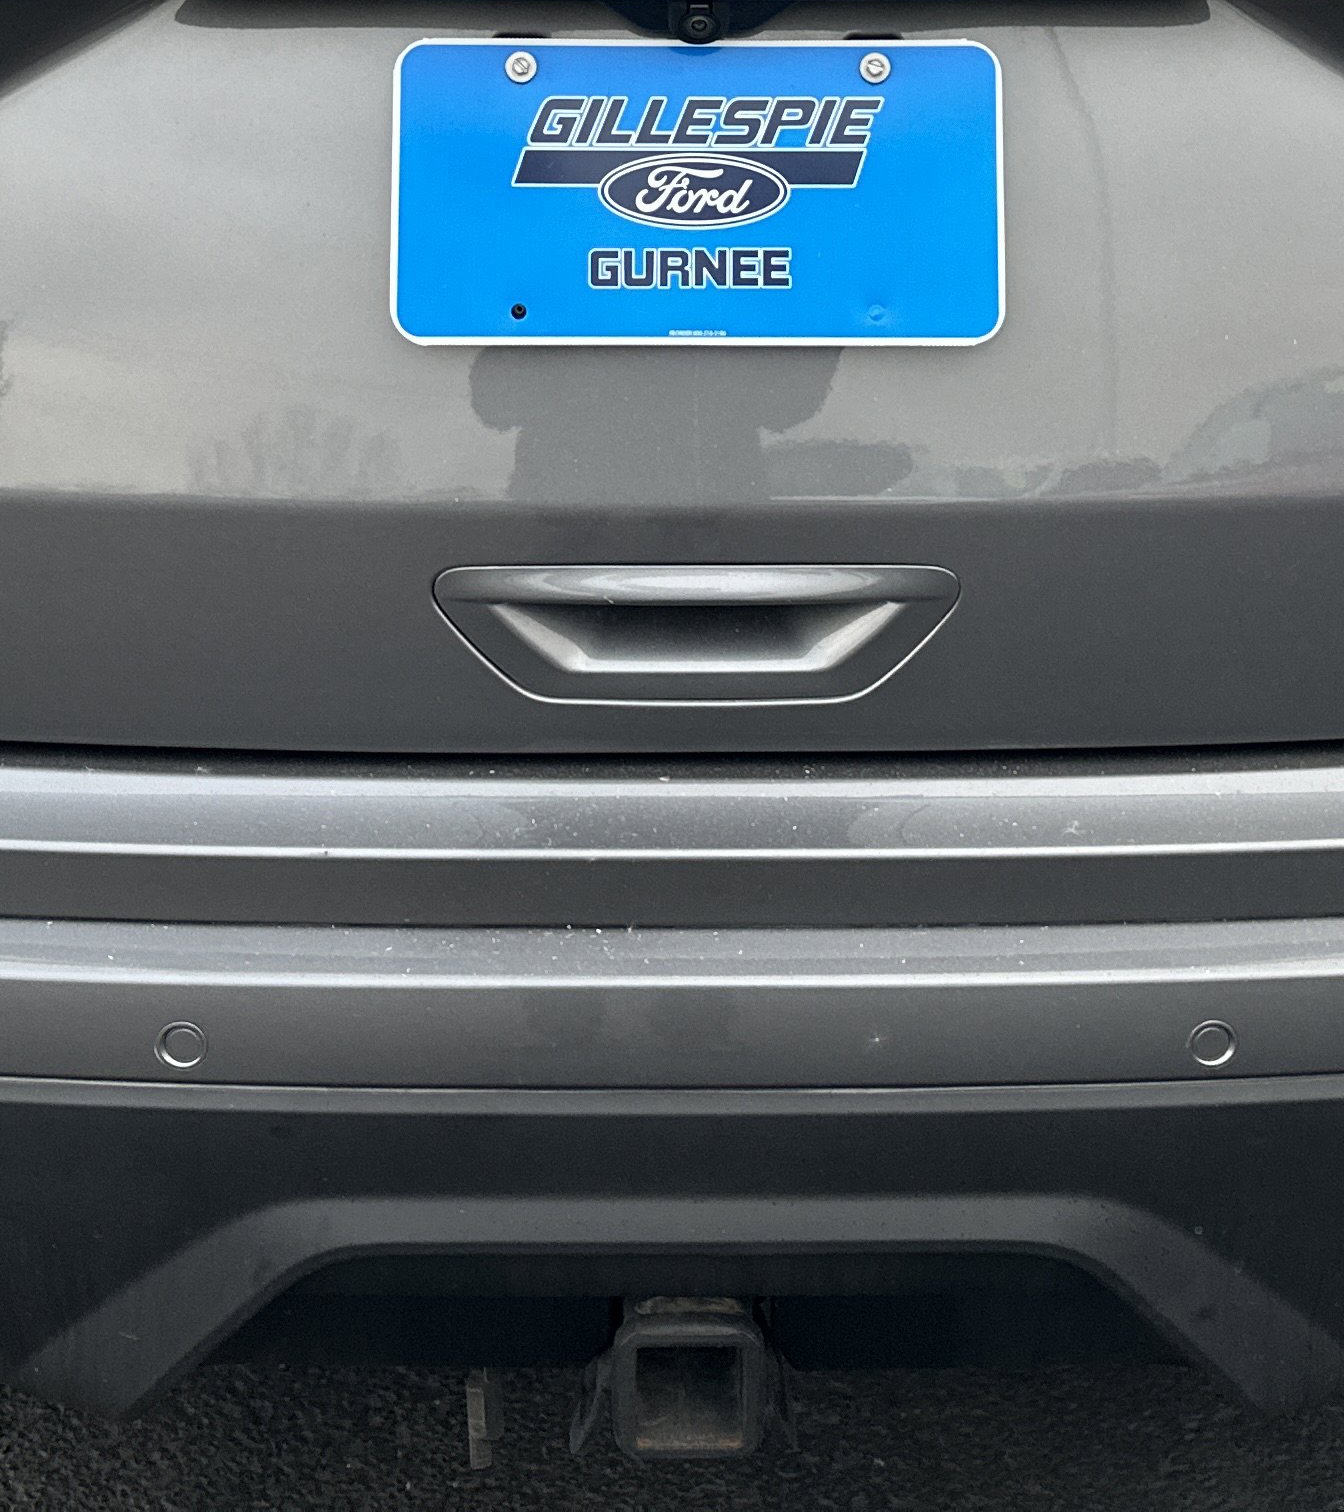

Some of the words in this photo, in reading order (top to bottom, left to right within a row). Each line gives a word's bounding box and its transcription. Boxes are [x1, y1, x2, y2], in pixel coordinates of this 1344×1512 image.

[526, 95, 884, 148] GILLESPIE
[636, 167, 752, 215] Ford
[588, 247, 792, 289] GURNEE
